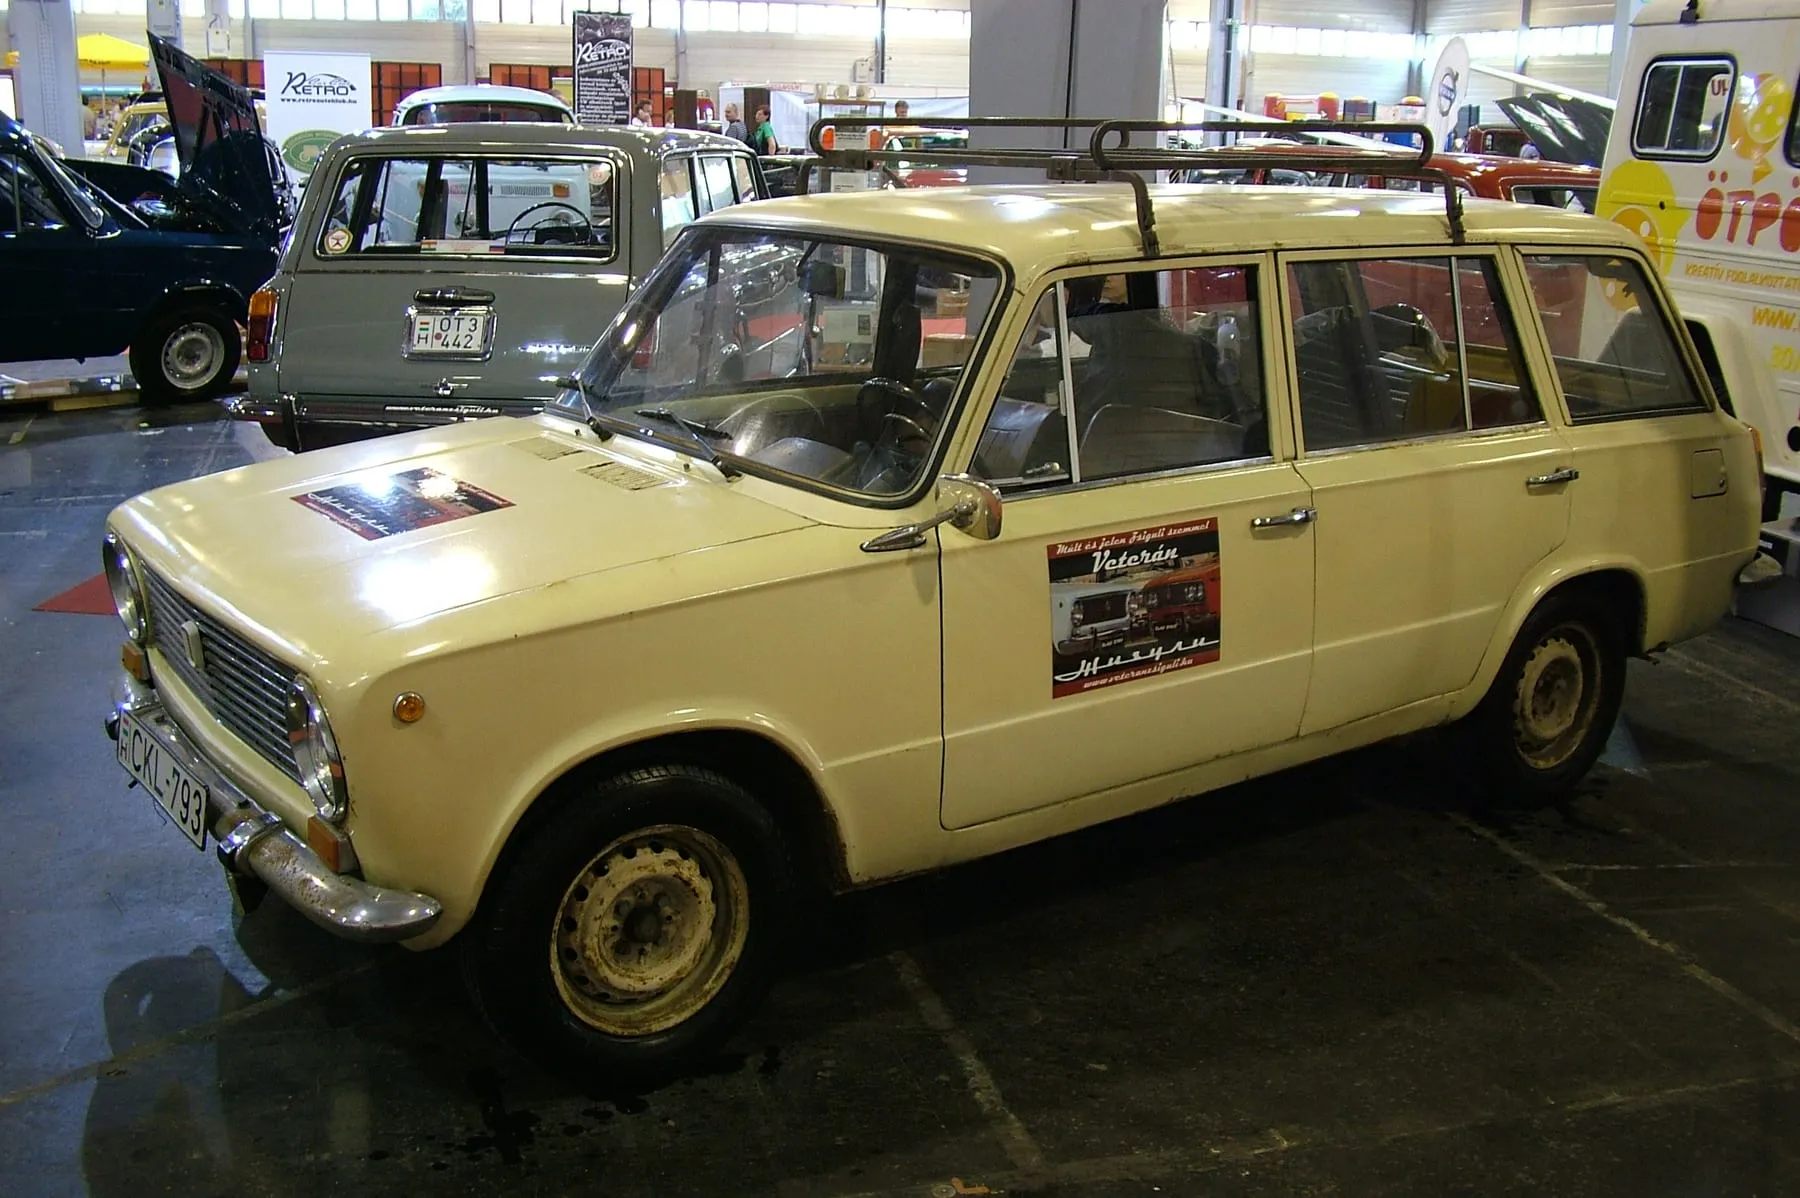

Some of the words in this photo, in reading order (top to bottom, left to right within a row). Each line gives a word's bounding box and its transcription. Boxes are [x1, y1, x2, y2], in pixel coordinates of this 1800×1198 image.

[1752, 306, 1800, 333] WWW.
[417, 334, 428, 344] H
[441, 334, 473, 349] 442
[1099, 537, 1126, 549] jelen
[1168, 520, 1210, 536] szemmel
[1092, 544, 1179, 573] Veterán
[132, 729, 202, 836] CKL-793
